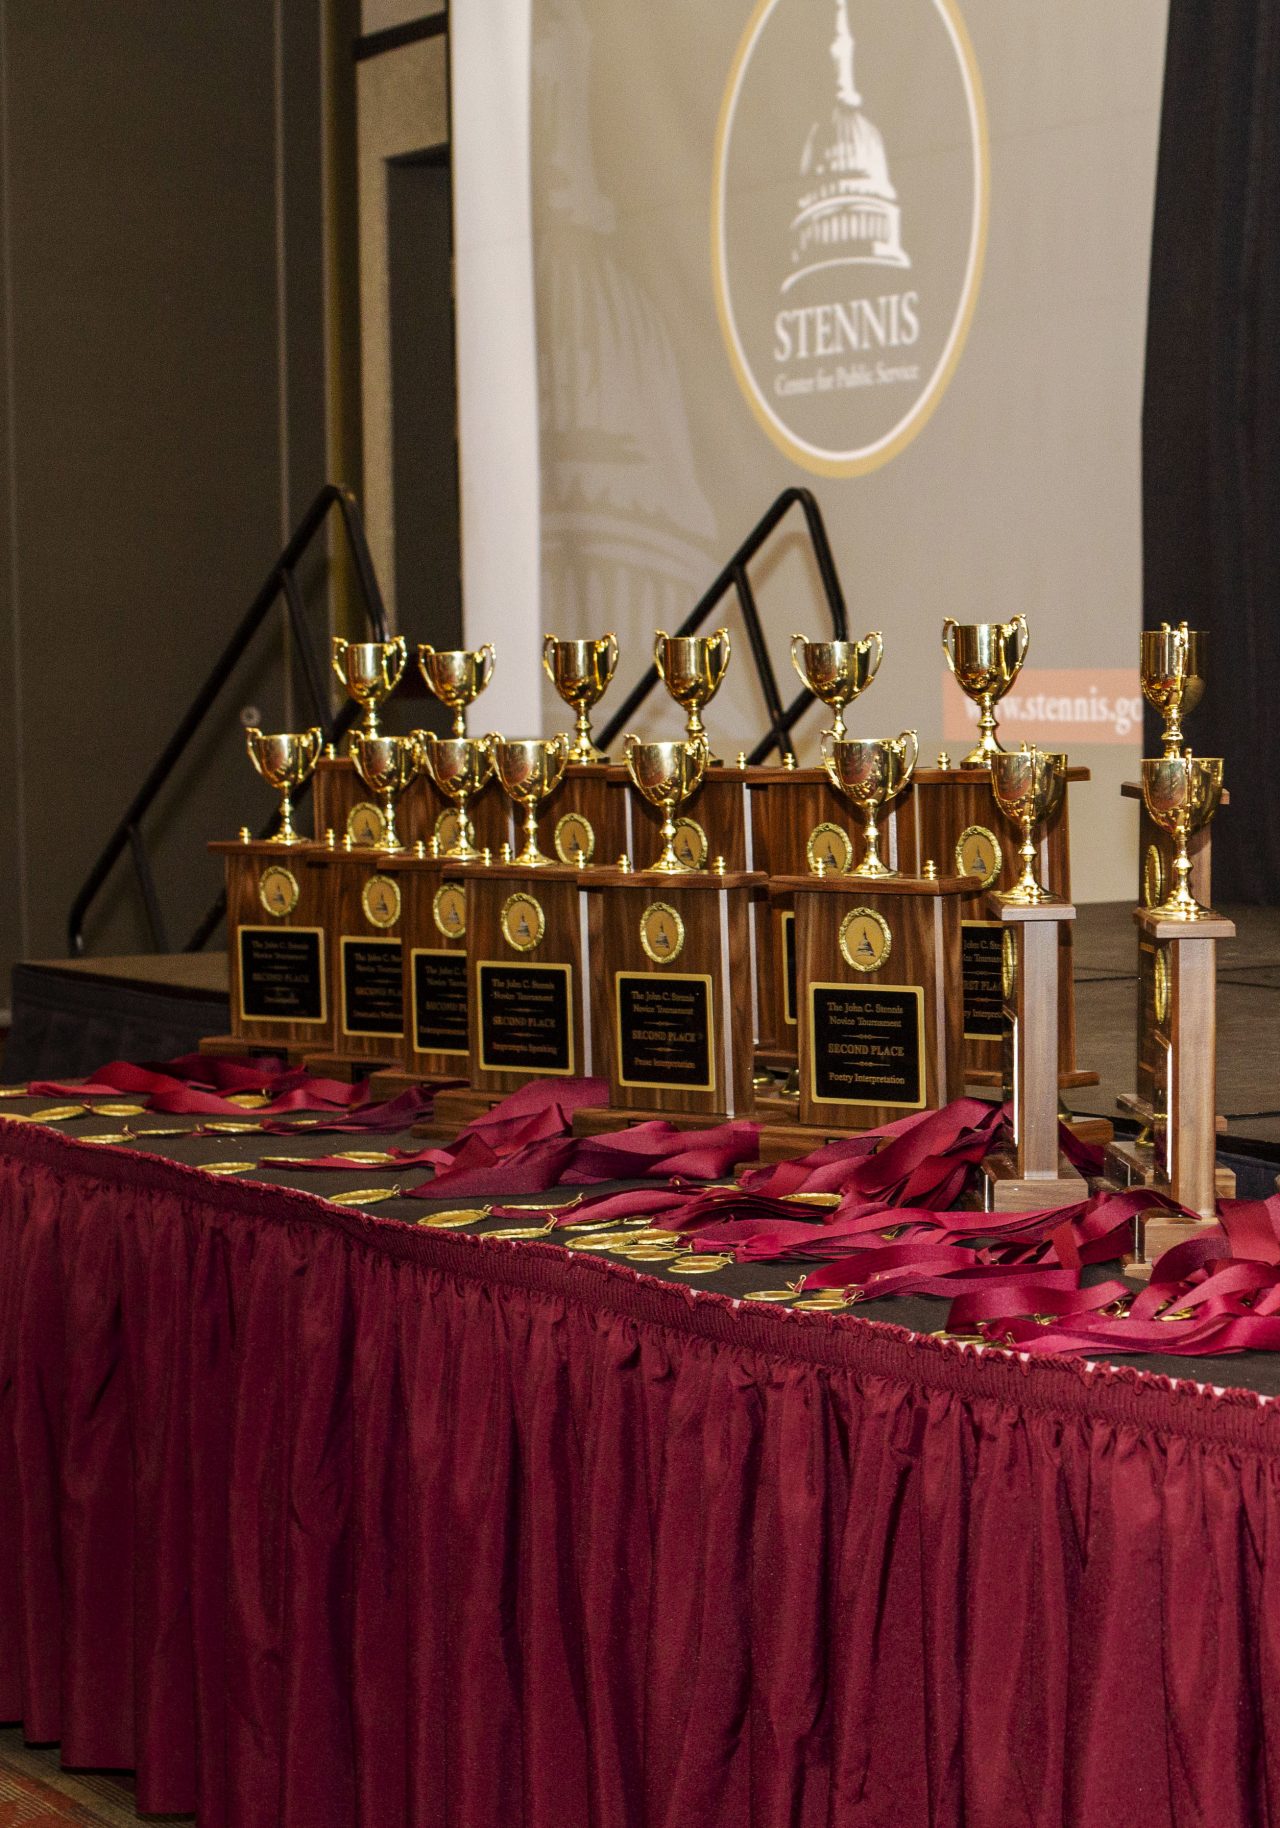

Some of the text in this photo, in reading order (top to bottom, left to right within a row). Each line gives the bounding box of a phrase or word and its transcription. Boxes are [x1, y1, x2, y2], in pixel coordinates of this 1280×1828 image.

[774, 291, 920, 362] STENNIS
[815, 367, 834, 390] for
[836, 363, 874, 389] Public
[876, 361, 919, 384] Service
[827, 1001, 843, 1012] The
[845, 1002, 863, 1013] John
[864, 1003, 874, 1013] C.
[828, 1016, 902, 1028] Novice Tournament
[632, 1030, 697, 1043] SECOND PLACE
[827, 1043, 905, 1057] SECOND PLACE
[828, 1072, 905, 1086] Poetry Interpretation
